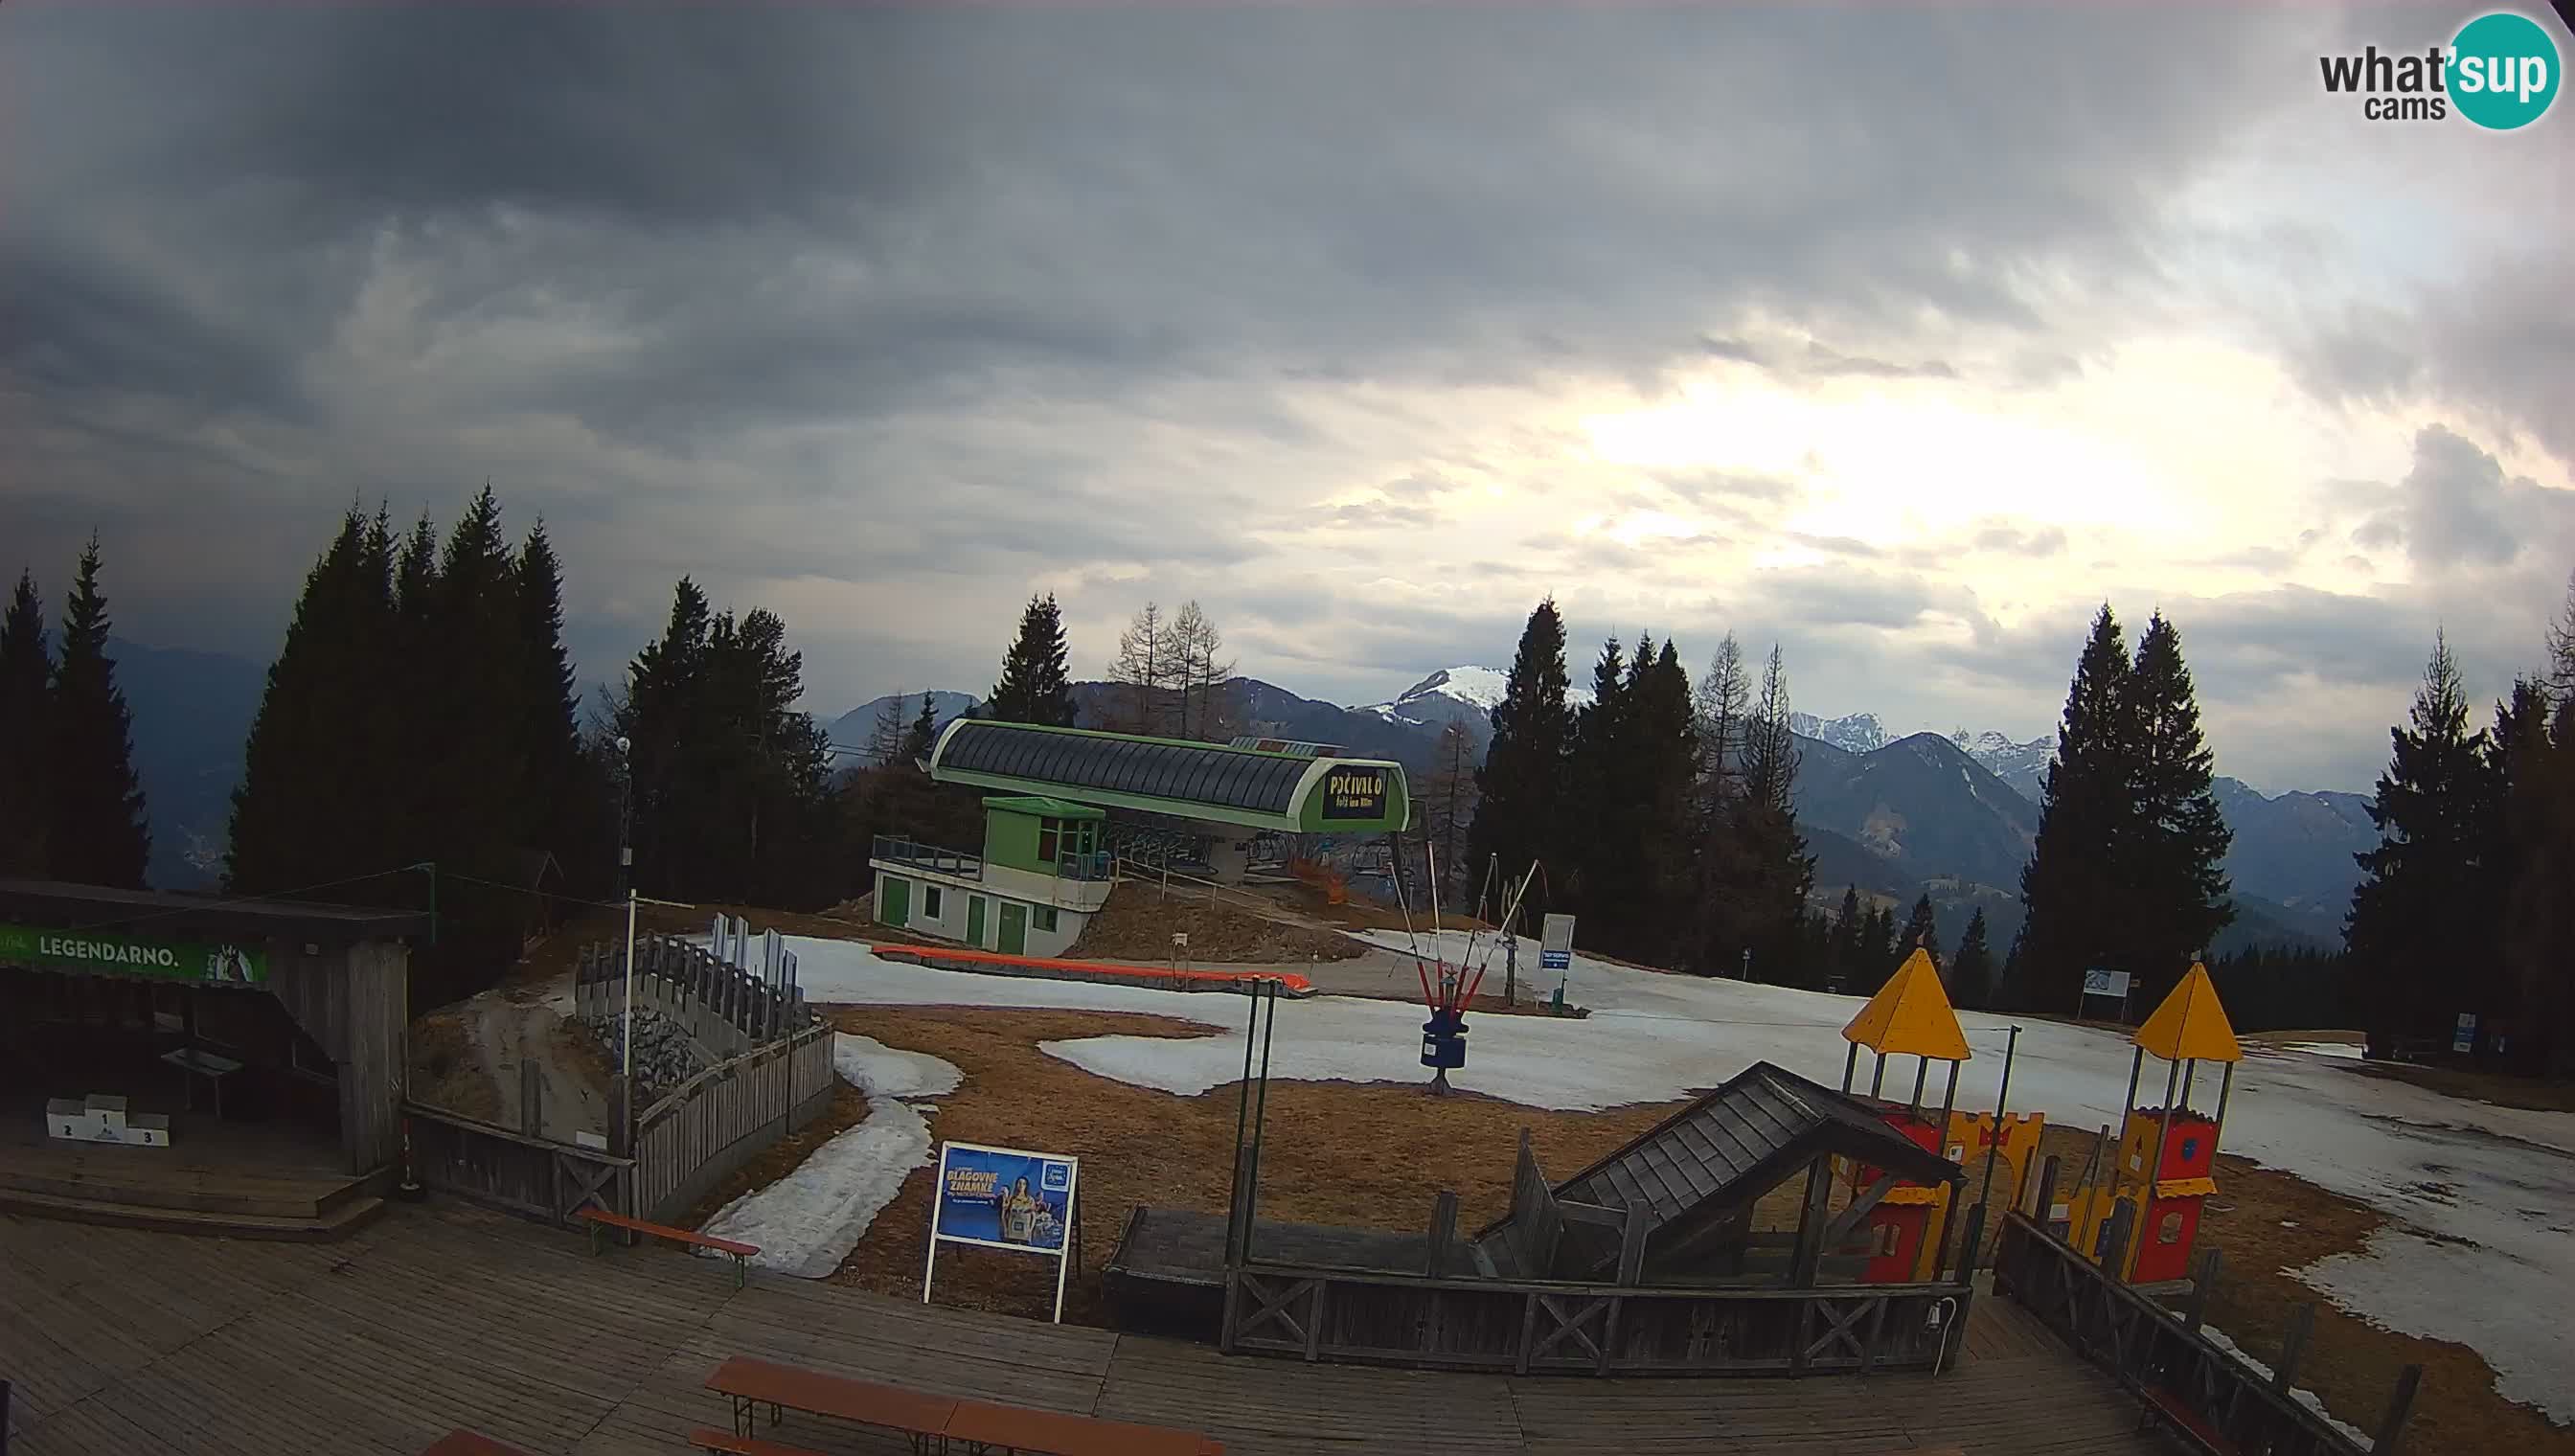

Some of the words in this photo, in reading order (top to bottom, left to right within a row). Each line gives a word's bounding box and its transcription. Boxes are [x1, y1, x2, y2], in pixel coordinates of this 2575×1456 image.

[39, 935, 180, 967] LEGENDARNO.
[102, 1113, 108, 1125] 1
[63, 1125, 73, 1136] 2
[144, 1131, 152, 1144] 3
[946, 1171, 999, 1184] BLAGOVNE
[949, 1180, 994, 1193] ZNAMKE
